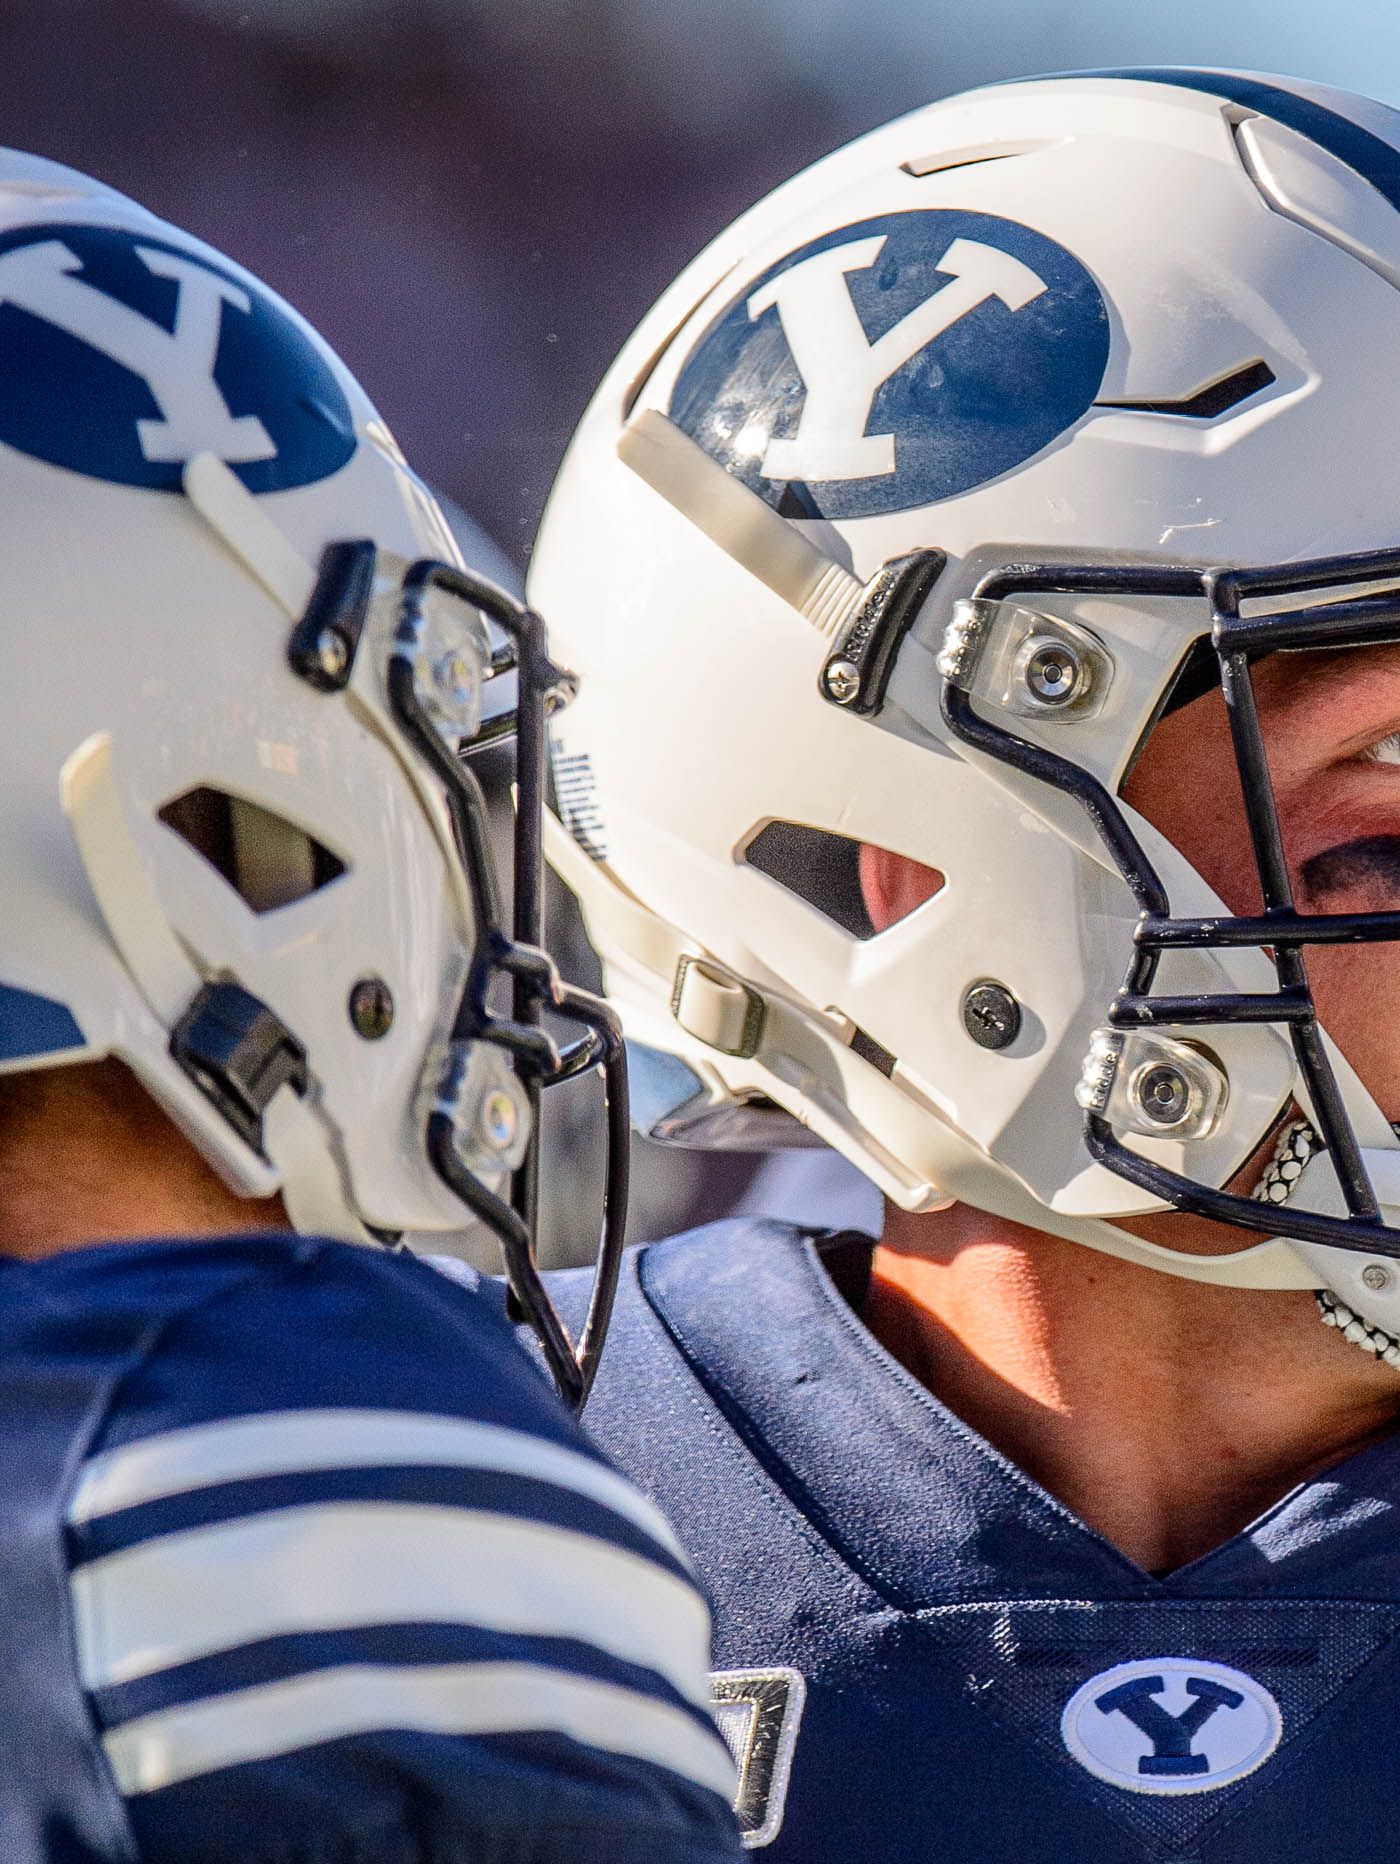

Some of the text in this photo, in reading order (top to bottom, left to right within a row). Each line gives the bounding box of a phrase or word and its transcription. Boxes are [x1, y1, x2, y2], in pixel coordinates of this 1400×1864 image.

[0, 240, 277, 463] Y
[747, 235, 1049, 482] Y
[1094, 1675, 1245, 1776] Y
